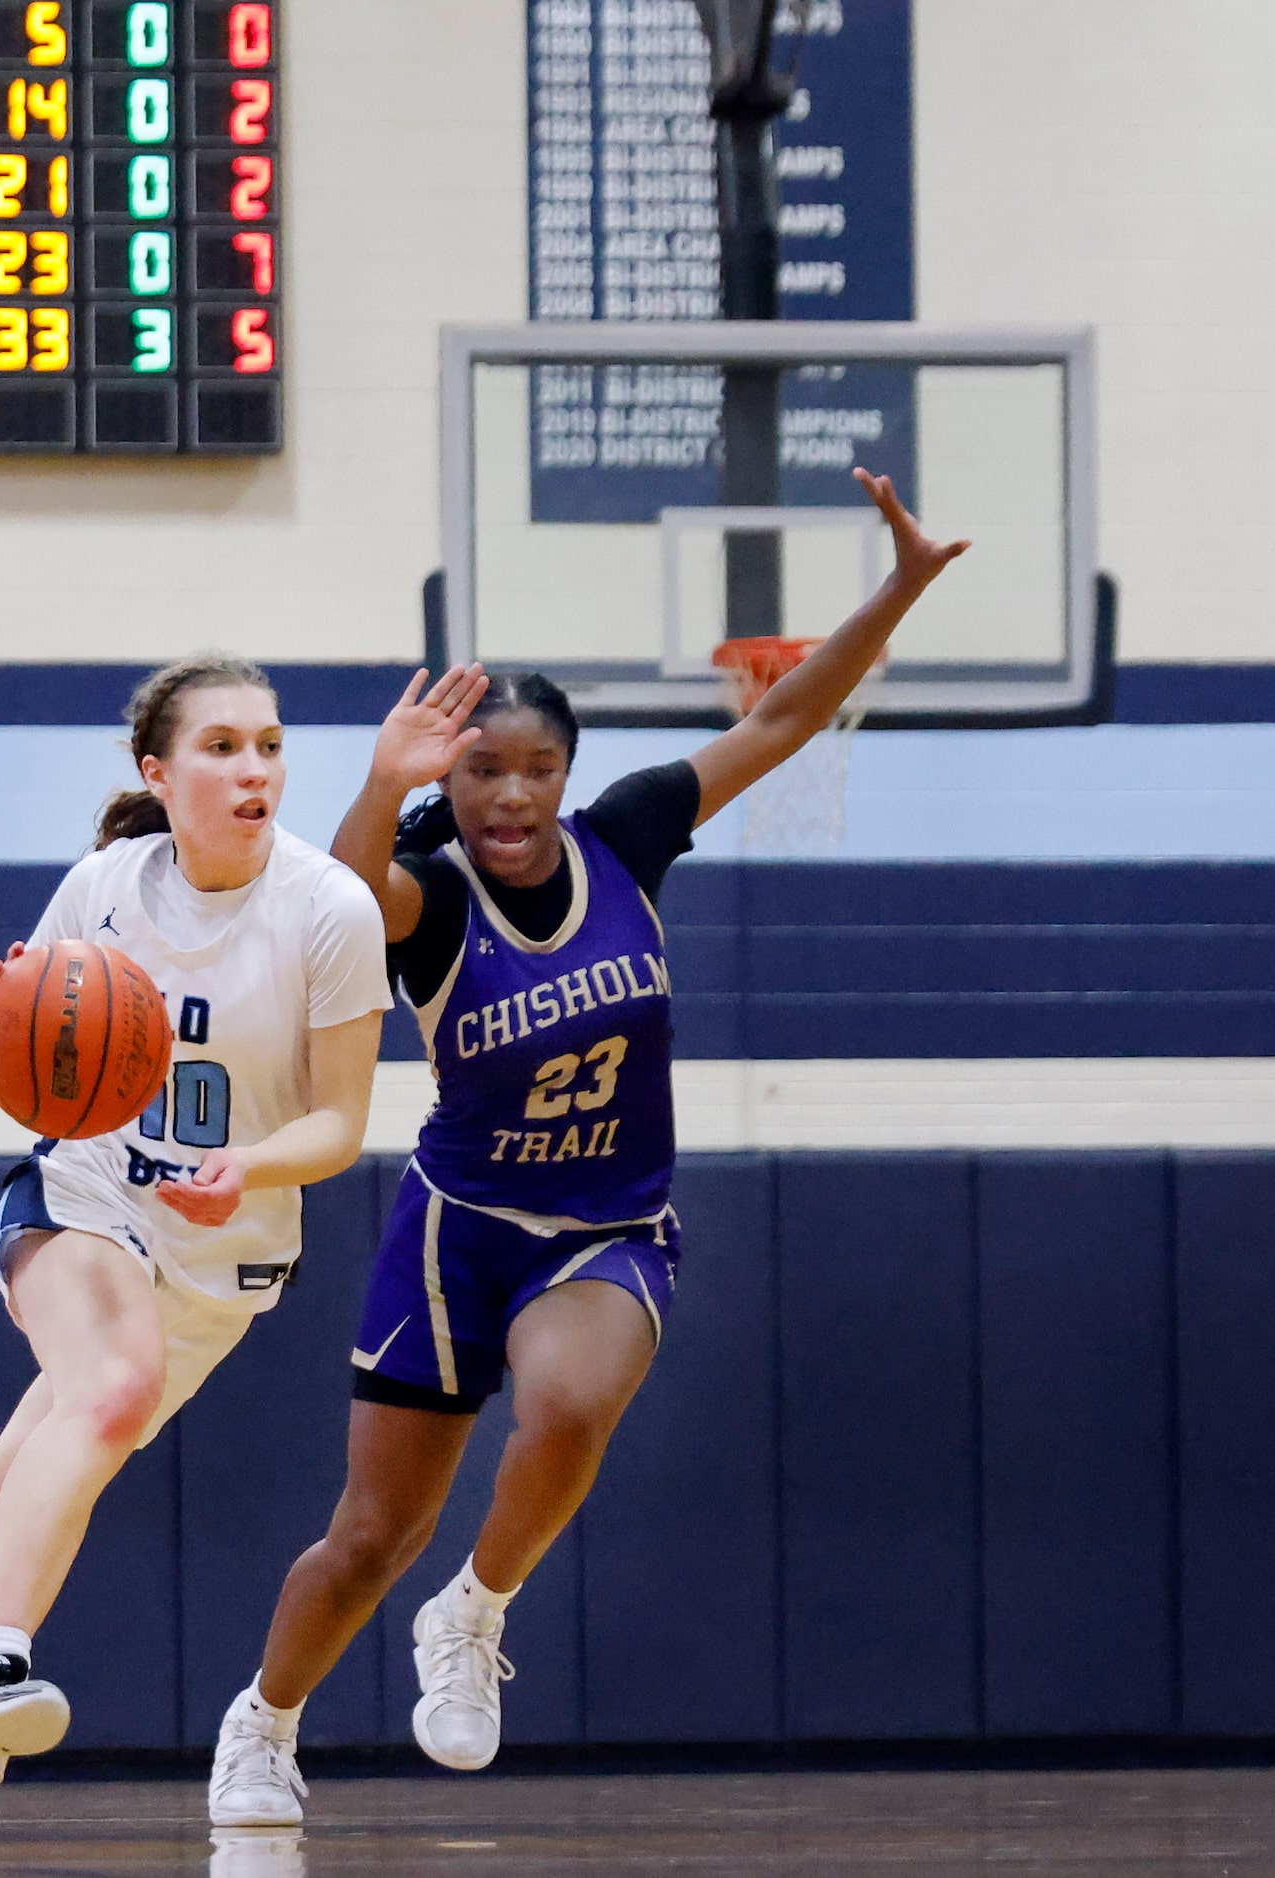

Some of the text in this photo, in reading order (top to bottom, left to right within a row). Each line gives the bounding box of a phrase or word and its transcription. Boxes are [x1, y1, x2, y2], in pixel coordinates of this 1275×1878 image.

[26, 2, 271, 68] 5 0 0
[8, 78, 272, 144] 14 0 2
[129, 155, 170, 219] 0
[231, 156, 272, 220] 2
[129, 231, 170, 295] 0
[232, 233, 273, 295] 7
[133, 308, 171, 372] 3
[233, 309, 274, 373] 5
[456, 952, 673, 1061] CHISHOLM
[523, 1034, 630, 1120] 23
